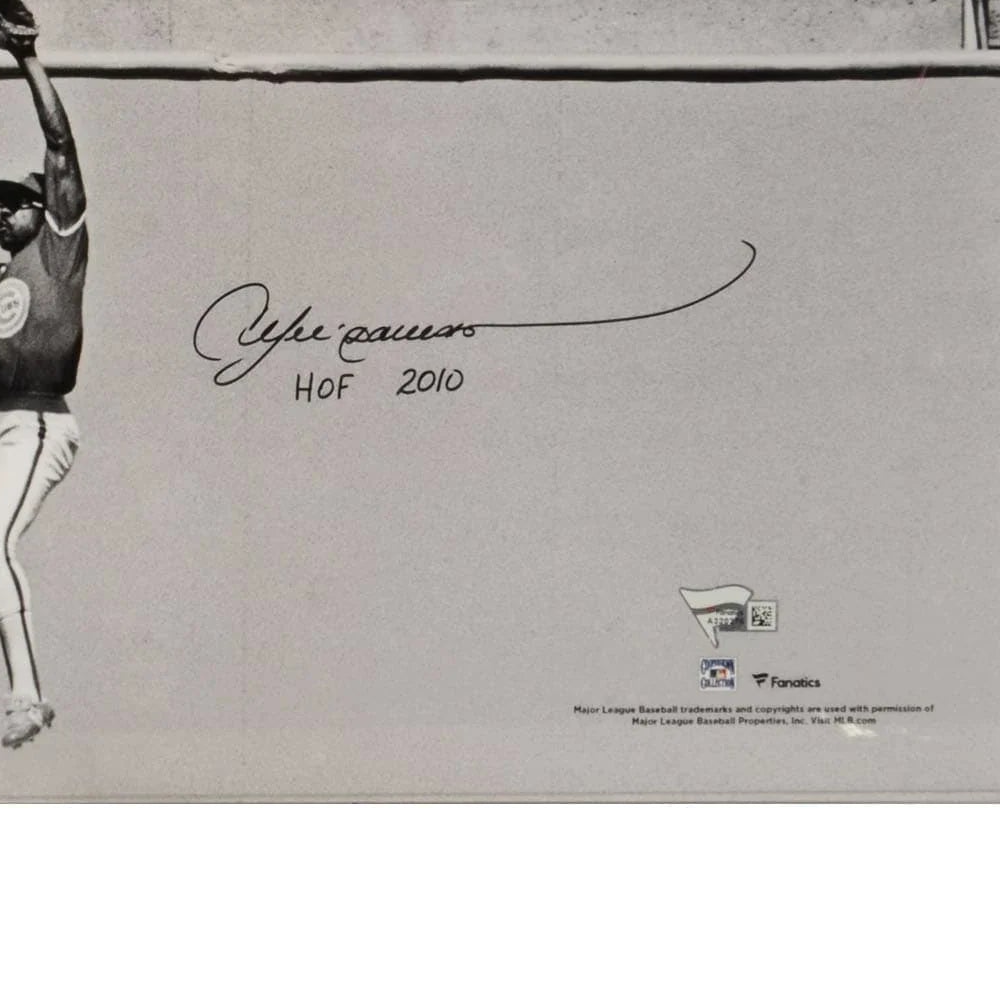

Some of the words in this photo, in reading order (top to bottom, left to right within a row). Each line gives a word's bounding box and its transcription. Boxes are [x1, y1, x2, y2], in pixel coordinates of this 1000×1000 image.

[295, 372, 355, 402] HOF
[396, 368, 465, 396] 2010
[770, 675, 822, 689] Fanatics
[573, 705, 599, 715] Major
[602, 705, 636, 715] League
[639, 705, 678, 714] Baseball
[680, 705, 732, 714] trademarks
[735, 705, 753, 713] and
[755, 704, 804, 714] copyrights
[824, 704, 847, 713] used
[849, 704, 869, 713] with
[871, 704, 922, 714] permission
[924, 704, 936, 713] of
[632, 717, 658, 727] Major
[660, 717, 694, 727] League
[696, 717, 736, 726] Baseball
